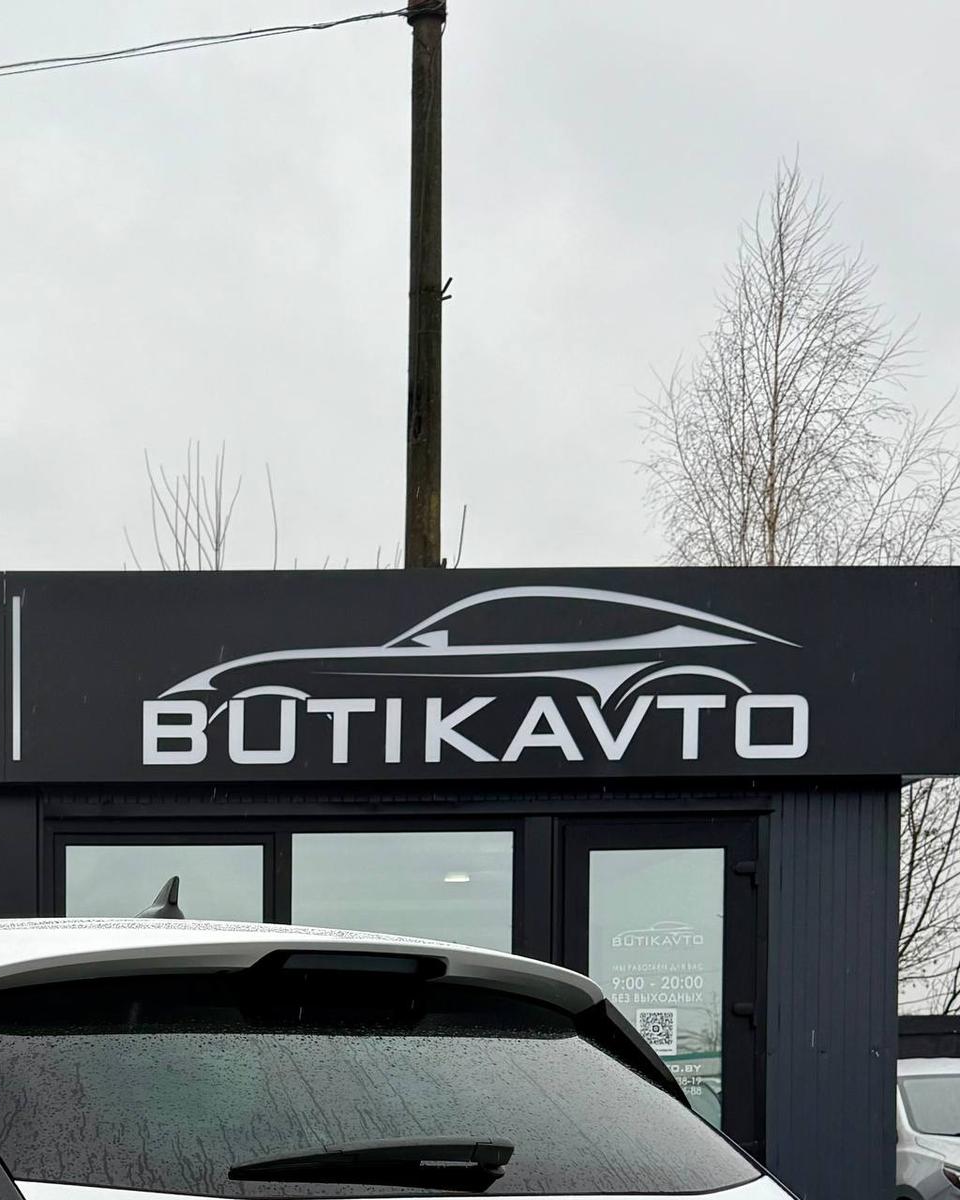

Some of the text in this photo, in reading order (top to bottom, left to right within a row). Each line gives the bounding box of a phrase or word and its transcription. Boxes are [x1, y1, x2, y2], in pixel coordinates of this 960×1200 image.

[142, 694, 809, 765] BUTIKAVTO
[611, 935, 704, 947] BUTIKAVTO
[612, 976, 644, 990] 9:00
[661, 976, 704, 990] 20:00
[611, 992, 703, 1004] БЕЗ ВЫХОДНЫХ
